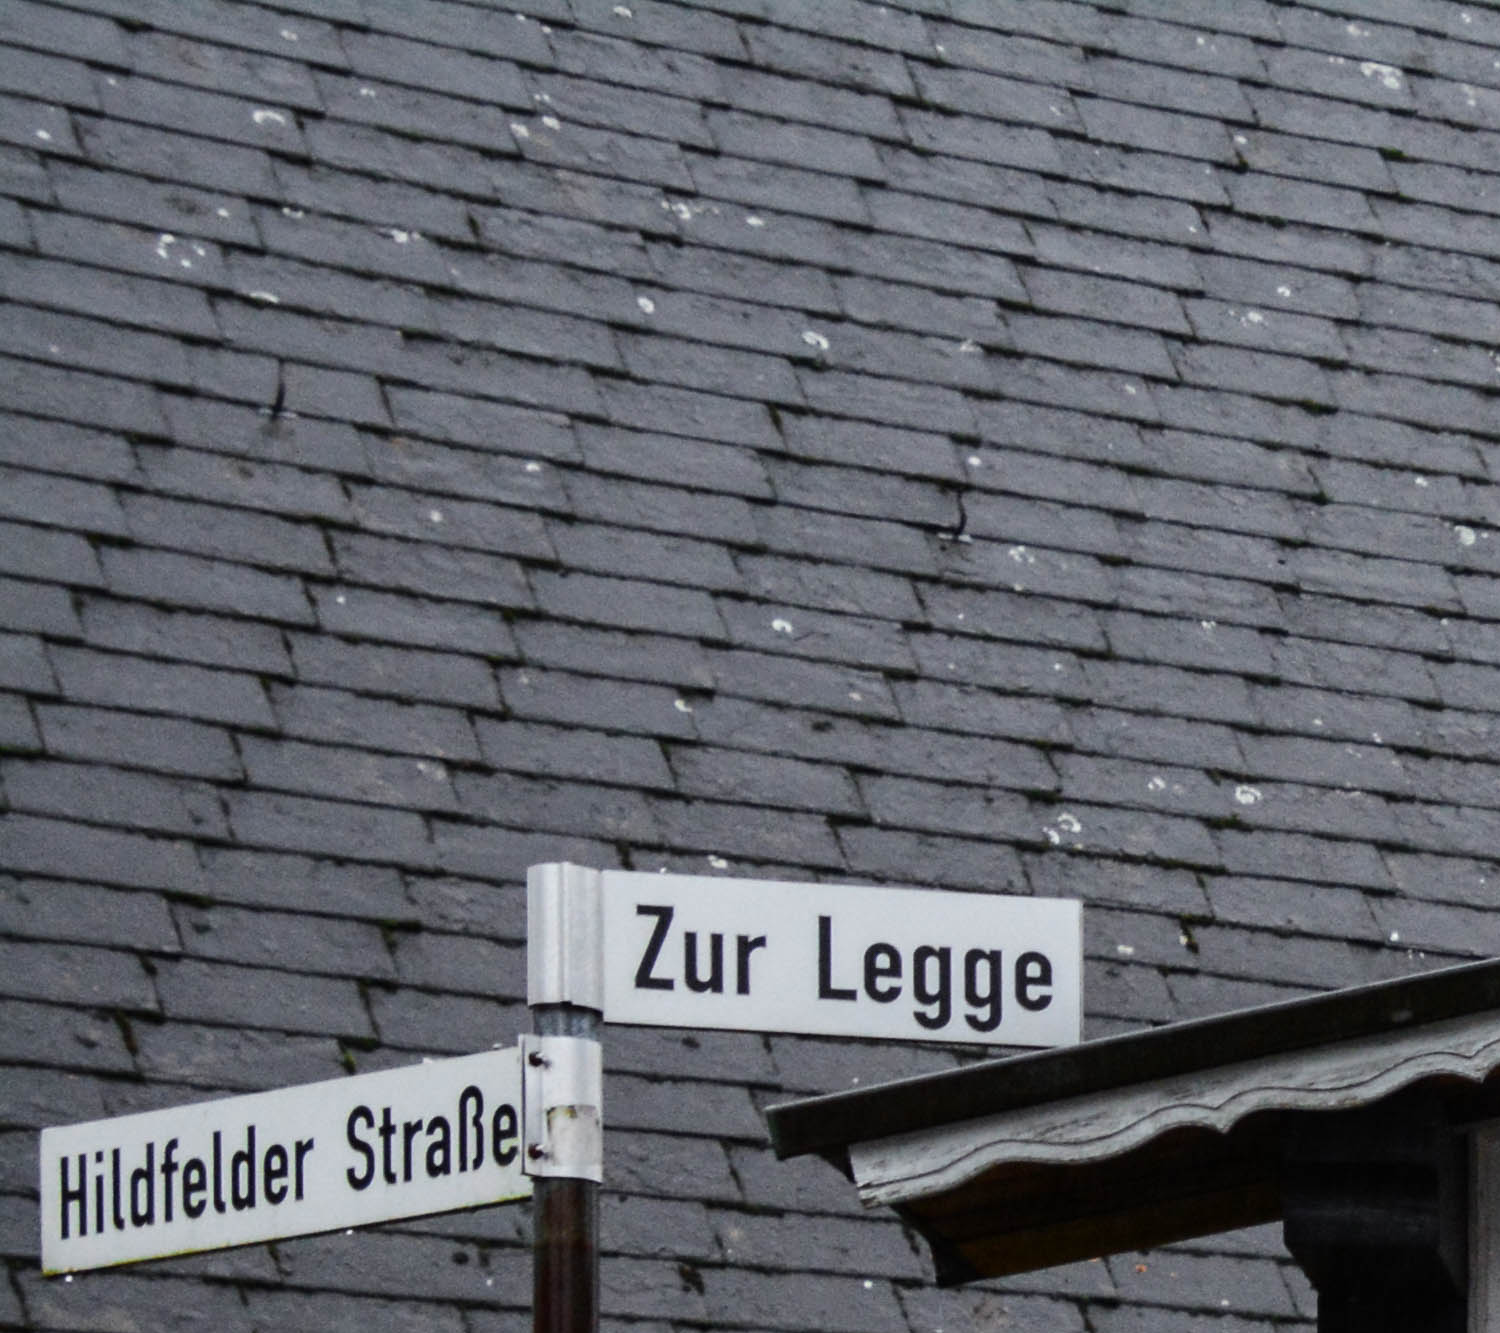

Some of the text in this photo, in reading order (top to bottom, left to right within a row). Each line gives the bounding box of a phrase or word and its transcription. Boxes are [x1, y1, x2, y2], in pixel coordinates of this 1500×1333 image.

[635, 905, 1055, 1031] Zur Legge
[58, 1085, 519, 1240] Hildfelder Straße
